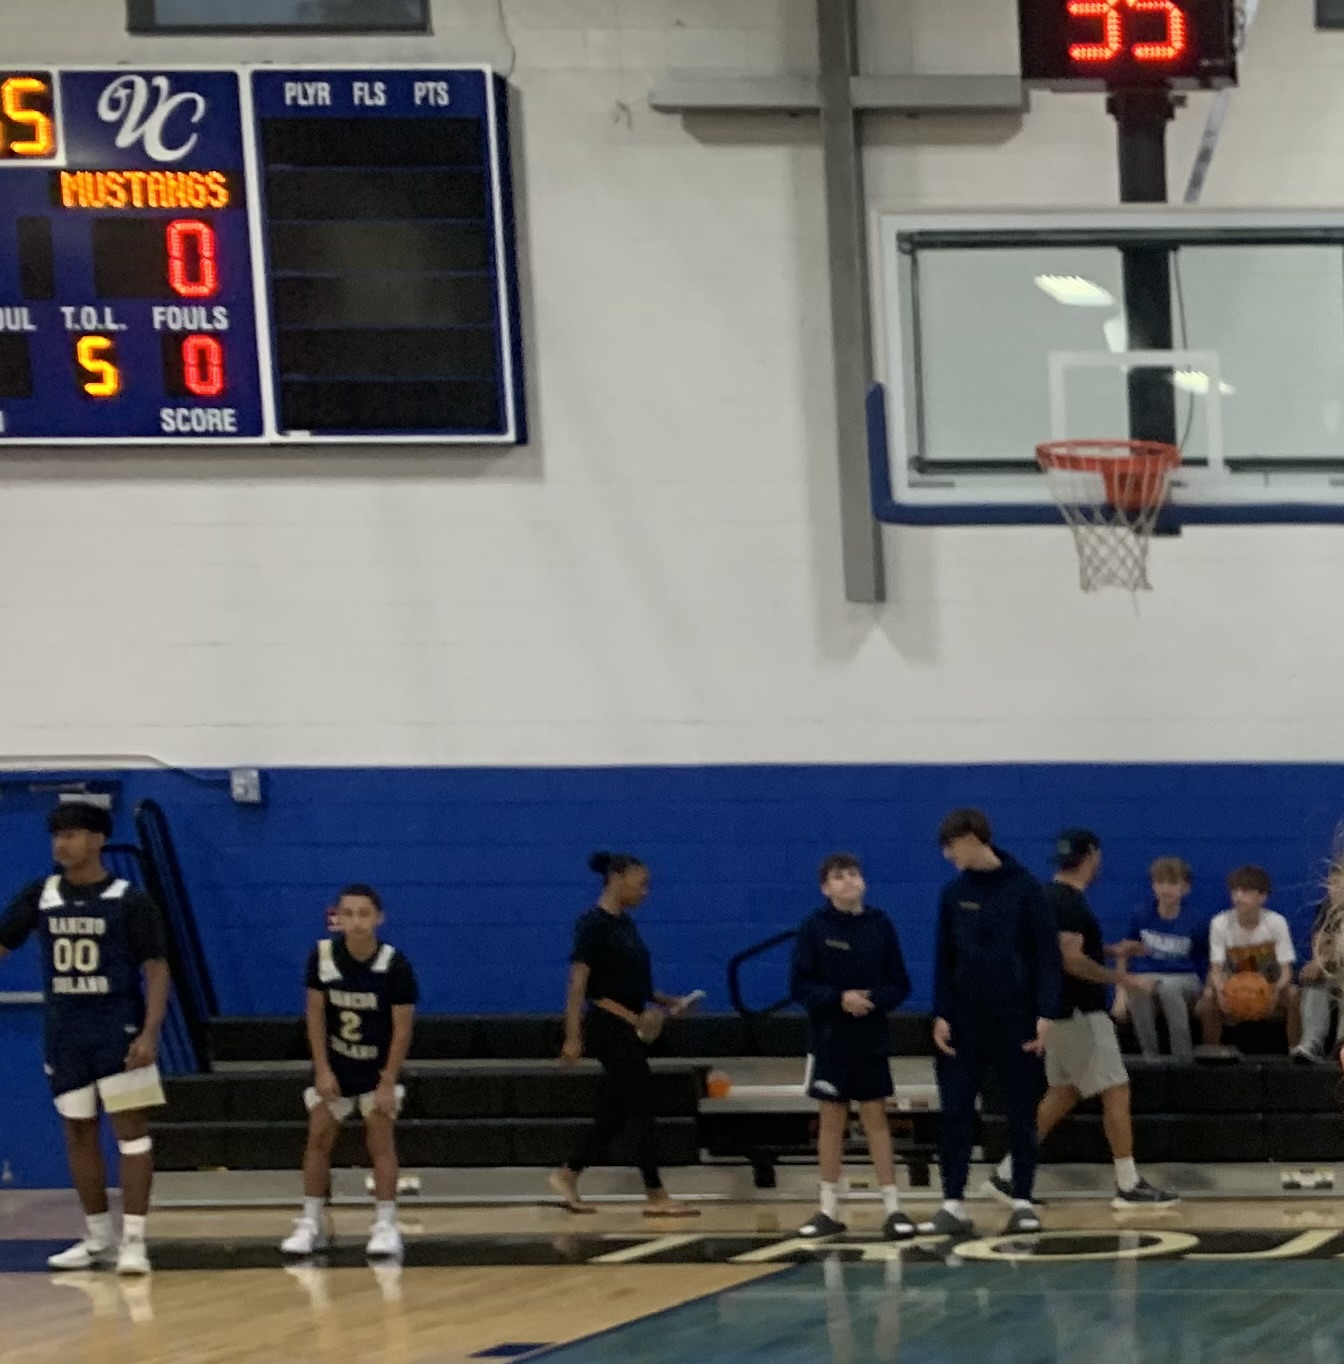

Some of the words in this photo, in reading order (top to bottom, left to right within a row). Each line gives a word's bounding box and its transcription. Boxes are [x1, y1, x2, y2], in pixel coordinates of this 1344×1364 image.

[284, 81, 331, 106] PLYR
[353, 81, 387, 106] FLS
[414, 81, 449, 106] PTS
[0, 77, 50, 155] 5
[60, 170, 229, 209] MUSTANGS
[166, 219, 218, 299] 0
[60, 306, 128, 331] T.O.L.
[152, 306, 230, 331] FOULS
[182, 334, 225, 396] 0
[160, 407, 238, 433] SCORE
[53, 937, 99, 973] 00
[340, 1010, 362, 1041] 2
